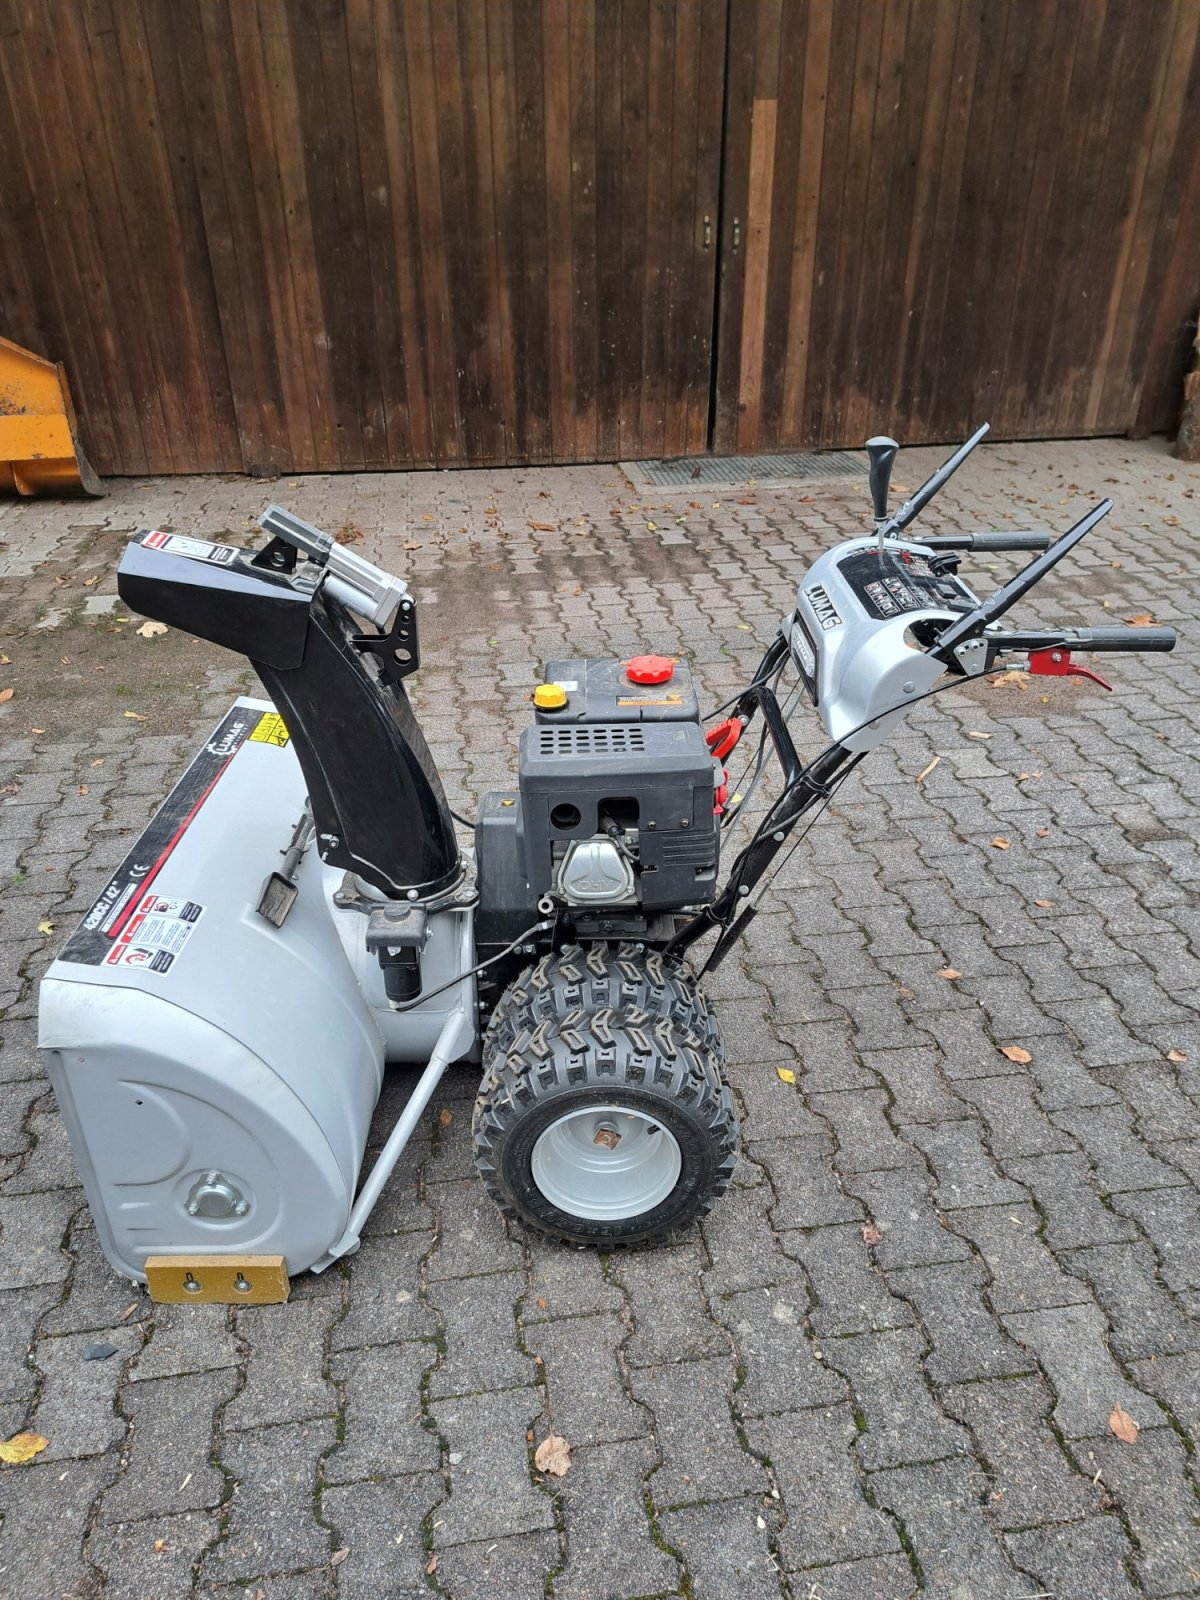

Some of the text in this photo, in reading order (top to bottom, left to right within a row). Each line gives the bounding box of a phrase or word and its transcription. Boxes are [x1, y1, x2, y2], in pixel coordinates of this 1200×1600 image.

[804, 584, 843, 631] LUMAG
[215, 722, 245, 752] LUMAG
[82, 901, 110, 931] 420CC
